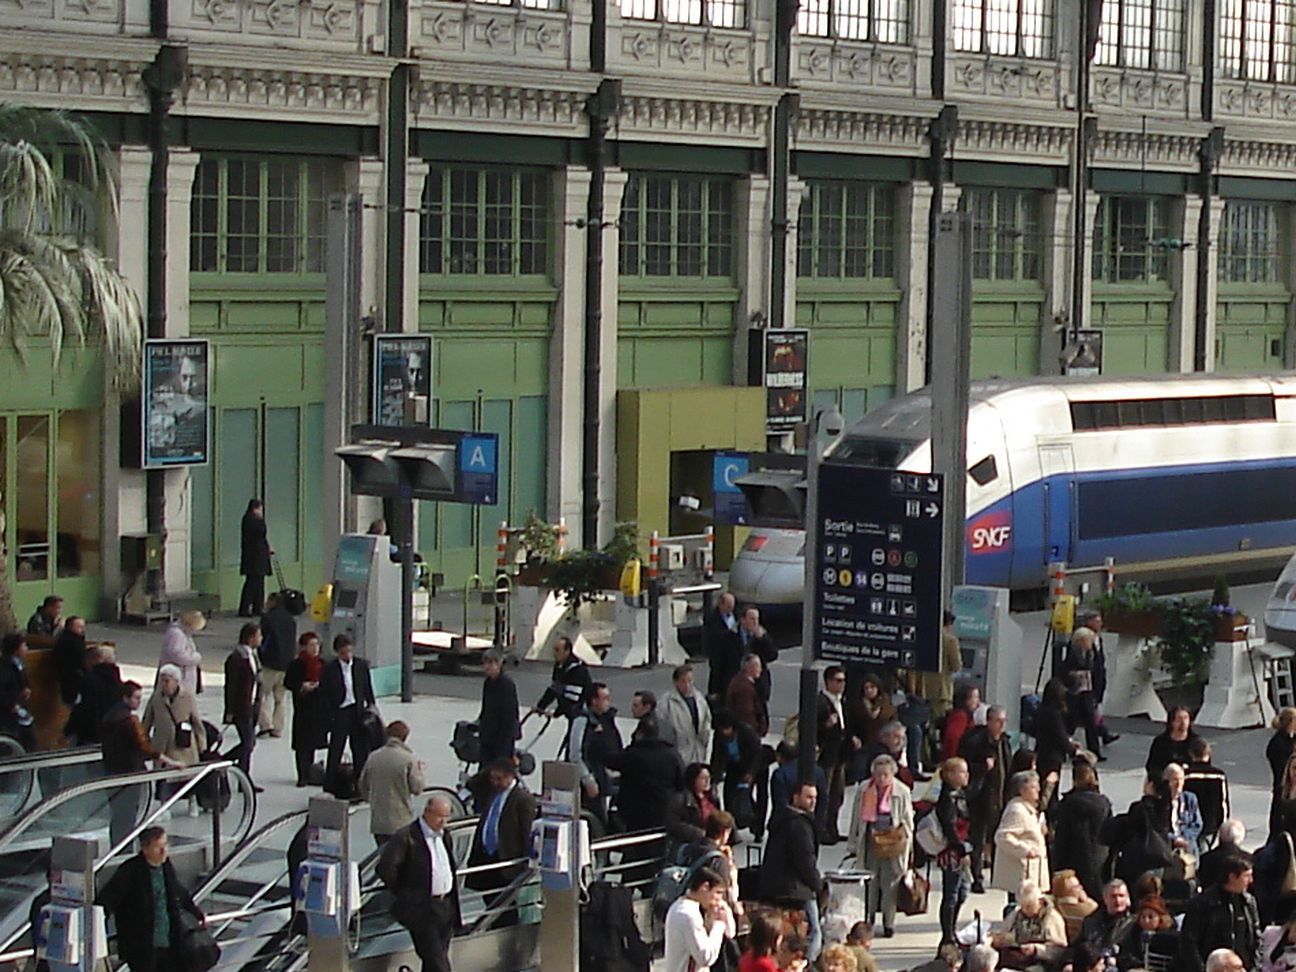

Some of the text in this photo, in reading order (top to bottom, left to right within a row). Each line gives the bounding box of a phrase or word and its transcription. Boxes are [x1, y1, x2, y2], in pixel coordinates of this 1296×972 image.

[470, 446, 487, 467] A
[724, 464, 739, 487] C
[825, 518, 854, 533] Sortie
[972, 526, 1011, 549] SNCF
[822, 617, 898, 633] Location de voitures
[821, 641, 859, 654] Boutiques
[861, 647, 871, 655] de
[872, 647, 880, 656] la
[881, 650, 899, 659] gare
